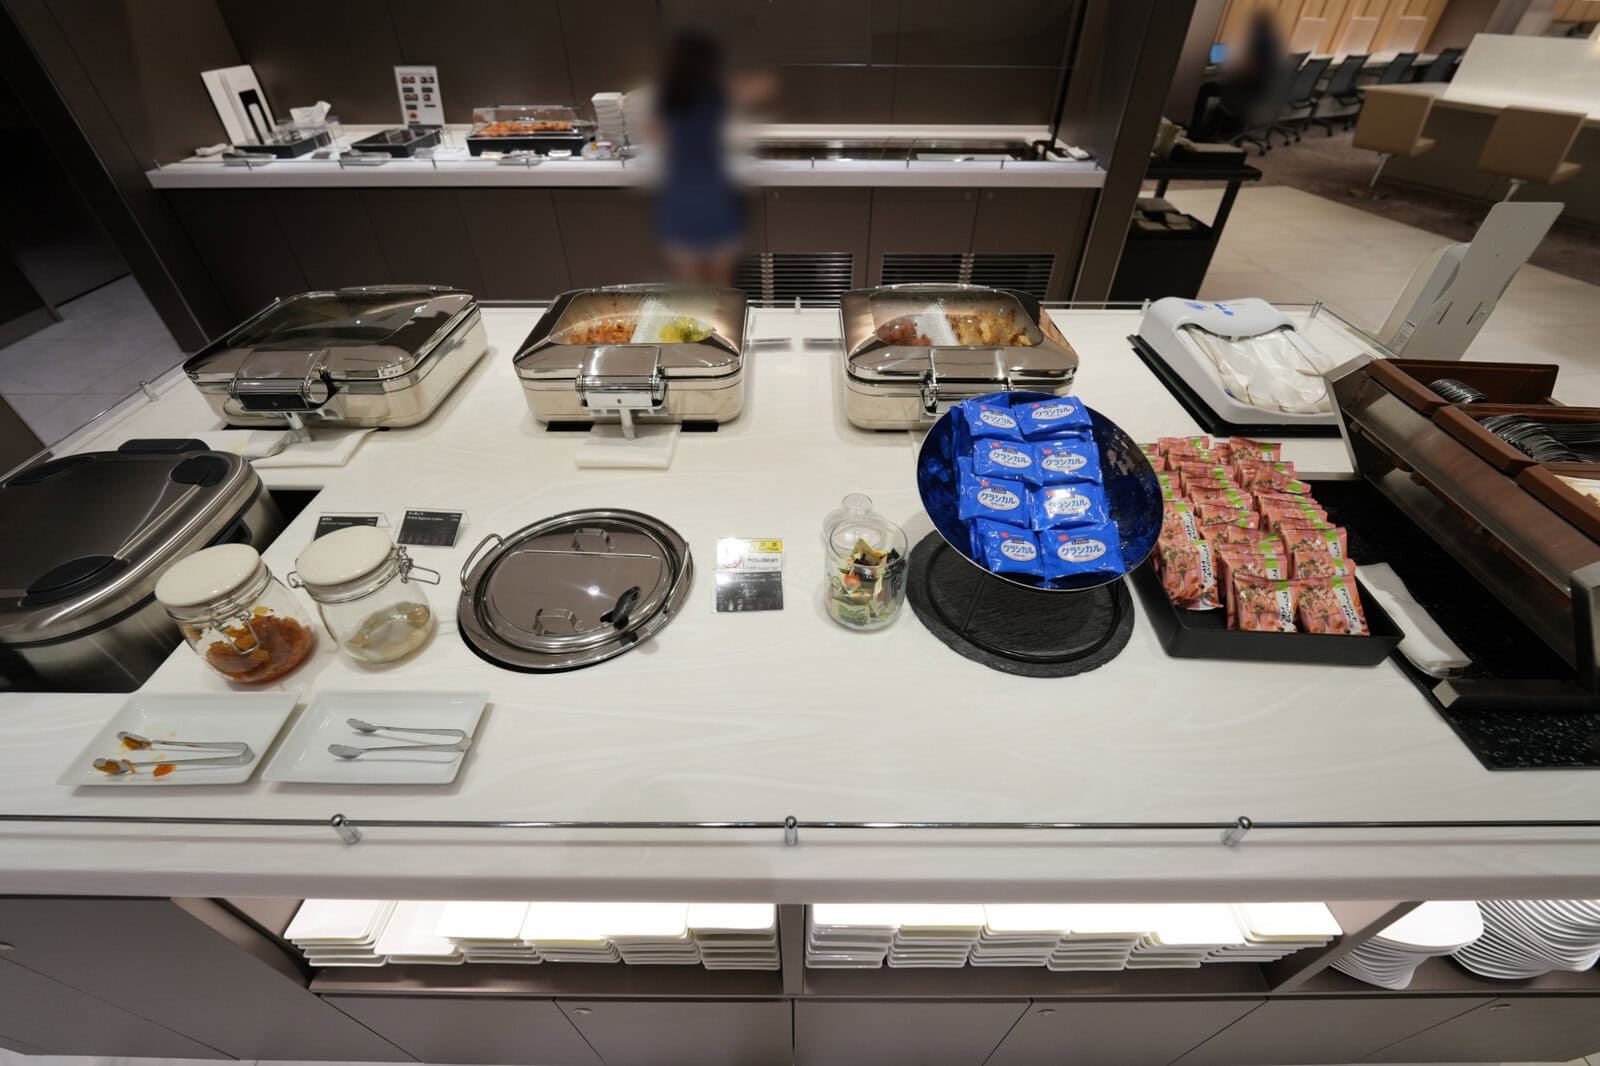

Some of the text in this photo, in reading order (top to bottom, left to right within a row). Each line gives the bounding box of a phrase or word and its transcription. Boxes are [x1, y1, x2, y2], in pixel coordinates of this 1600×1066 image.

[992, 452, 1026, 463] クラシカル
[1045, 457, 1082, 466] クラシカル
[981, 493, 1016, 504] クラシカル
[1002, 545, 1034, 554] クラシカル
[1062, 544, 1102, 556] クラシカル
